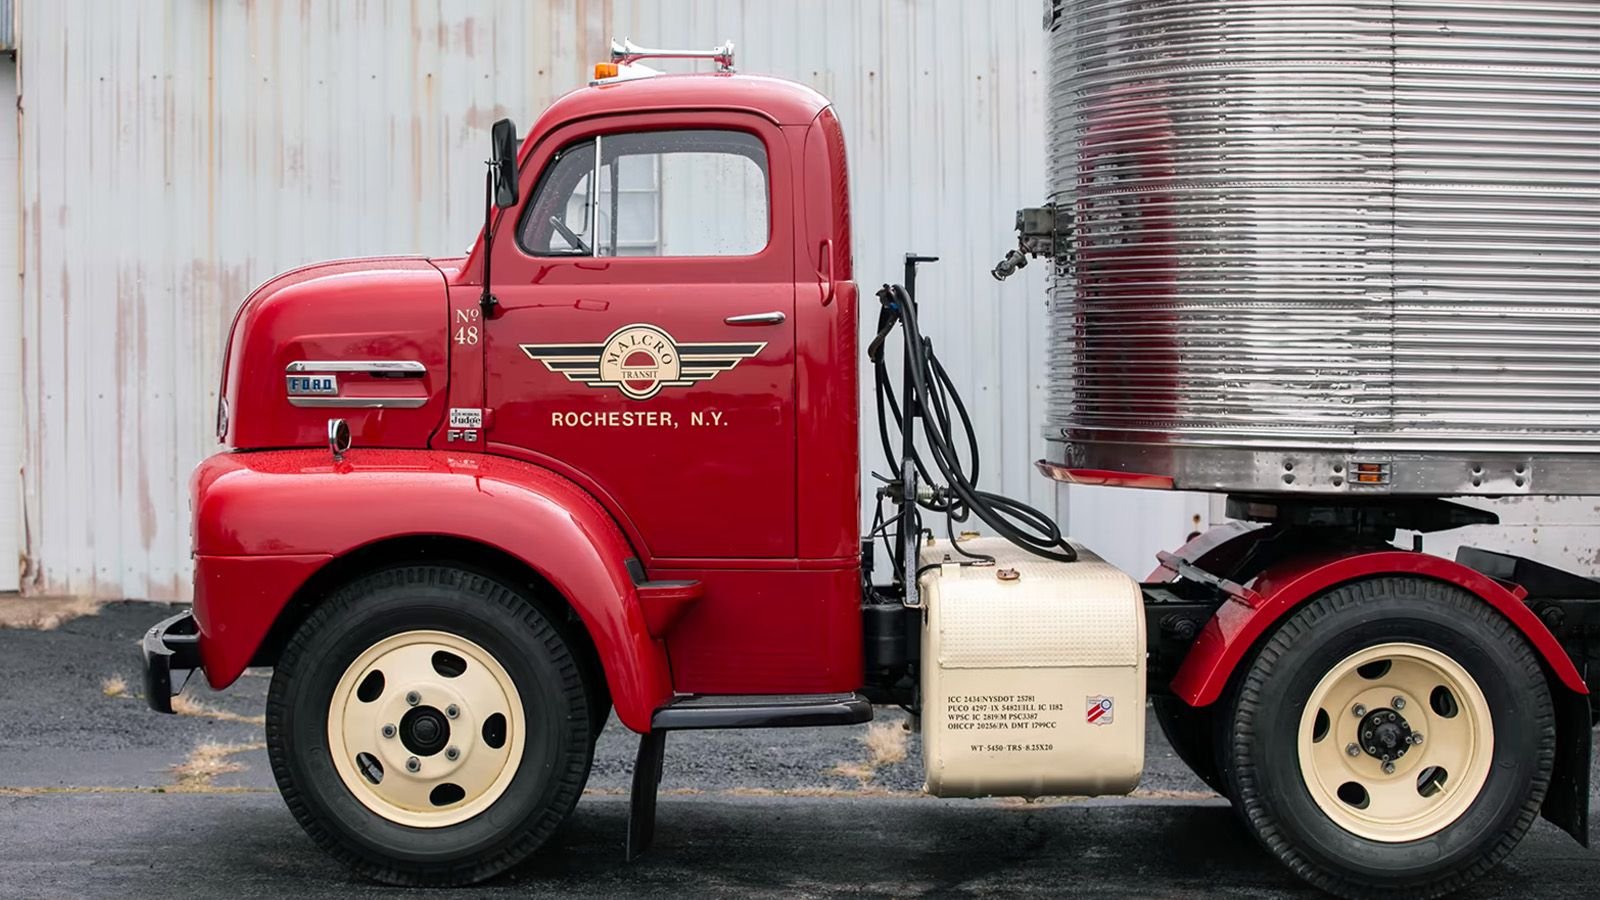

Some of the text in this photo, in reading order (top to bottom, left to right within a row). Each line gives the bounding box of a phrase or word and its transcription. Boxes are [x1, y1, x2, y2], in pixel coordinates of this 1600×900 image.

[454, 326, 478, 345] 48
[607, 334, 673, 367] MALCRO
[621, 370, 659, 379] TRANSIT
[290, 378, 332, 391] FORD
[451, 416, 481, 427] Judge
[551, 411, 728, 429] ROCHESTER, N.Y.
[947, 695, 961, 703] ICC
[947, 704, 969, 712] PUCO
[1038, 703, 1047, 711] IC
[948, 713, 970, 721] WPSC
[972, 713, 981, 721] IC
[947, 722, 975, 730] OHCCP
